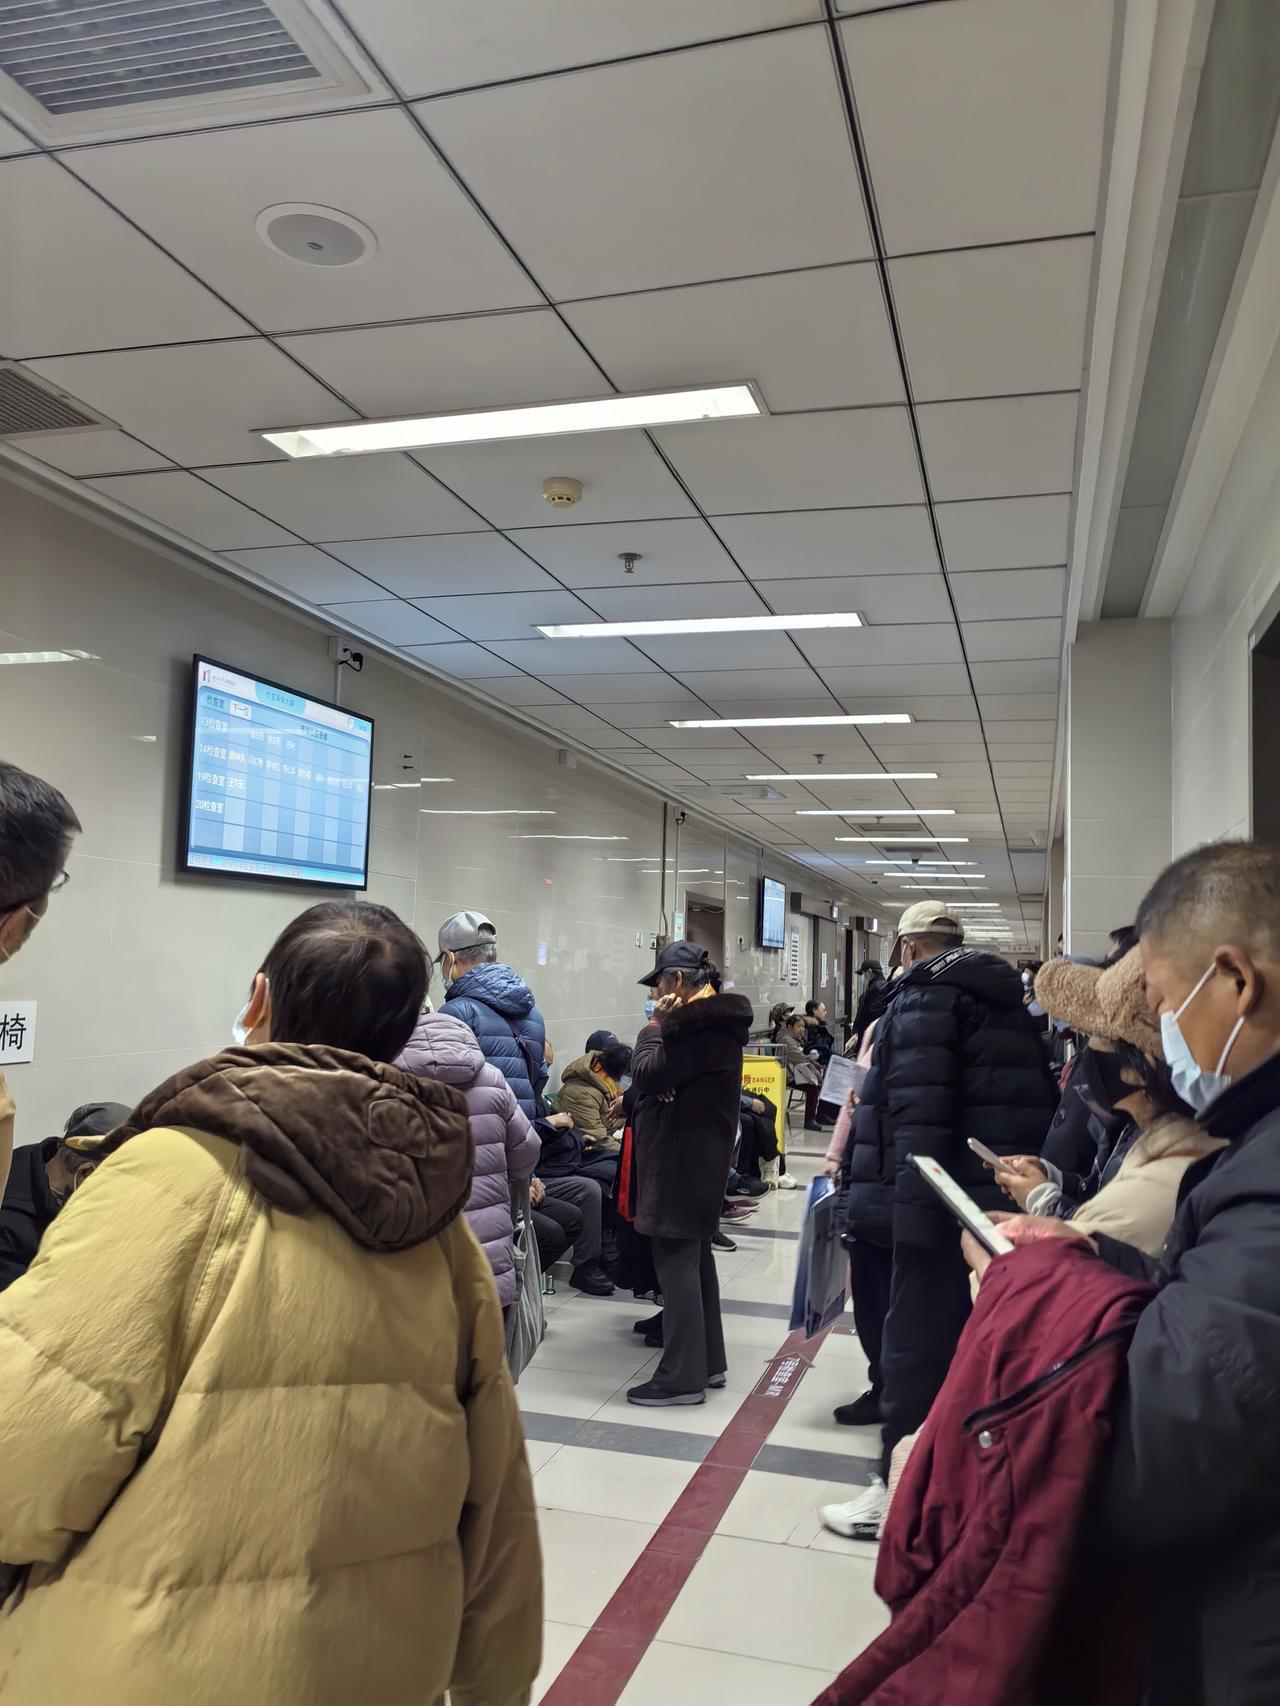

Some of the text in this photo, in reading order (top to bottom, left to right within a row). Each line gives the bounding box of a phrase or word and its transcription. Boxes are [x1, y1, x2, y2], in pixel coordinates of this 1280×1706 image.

[197, 772, 226, 787] 19检查室
[195, 799, 224, 814] 20检查室
[0, 1013, 26, 1051] 椅
